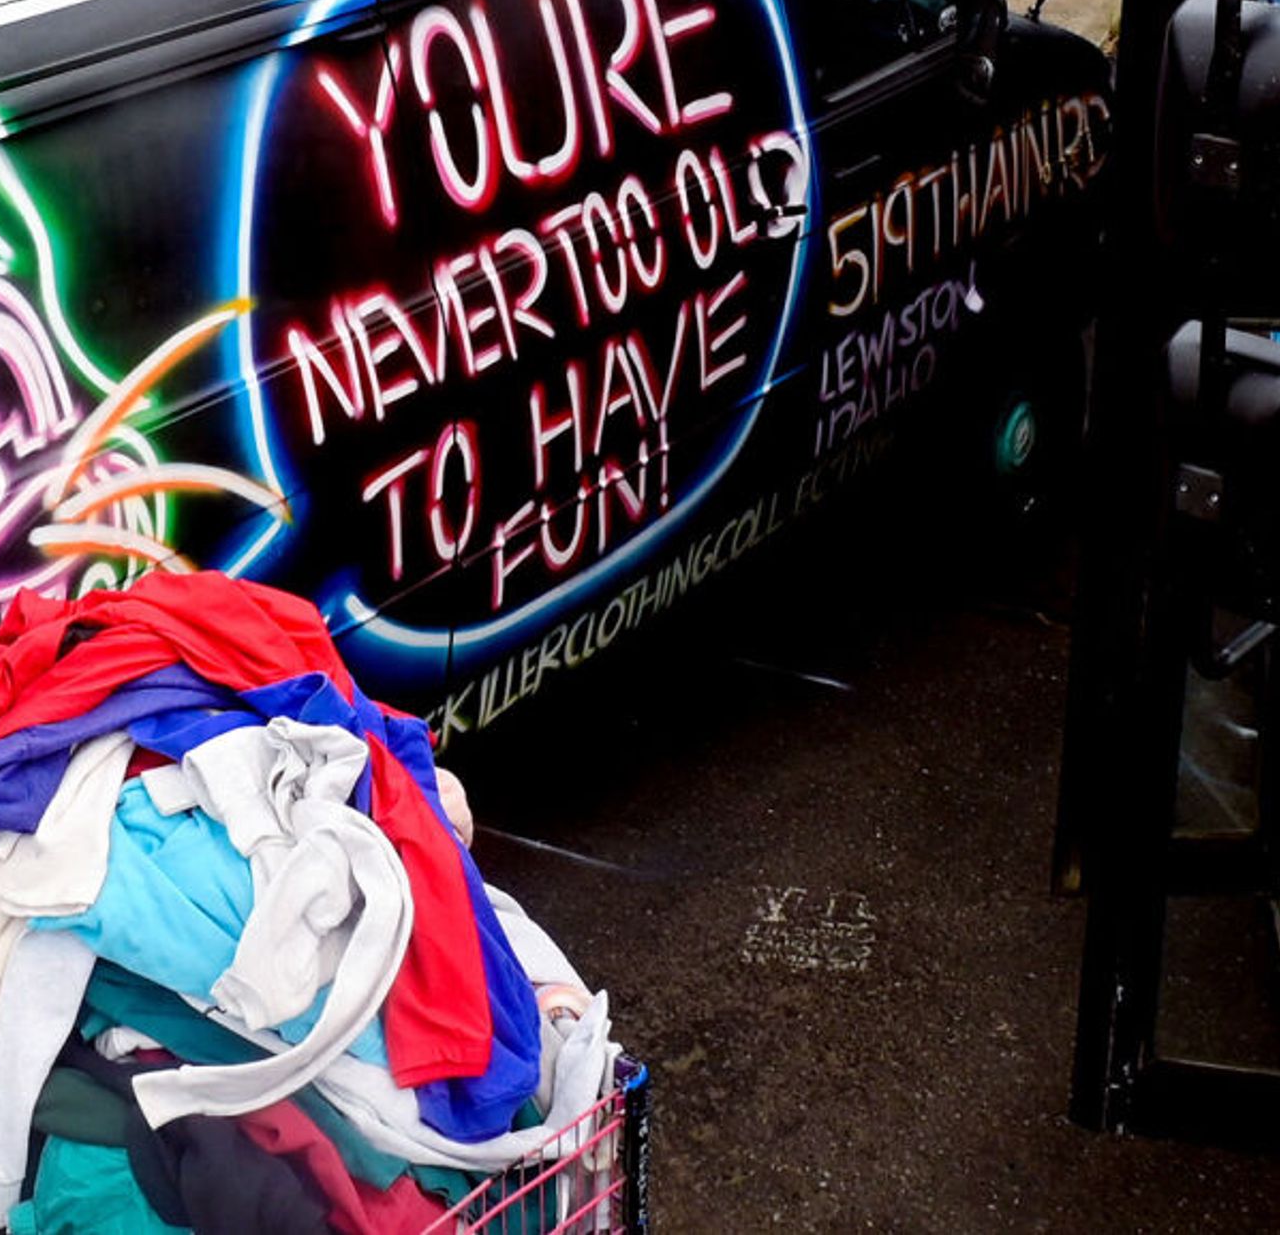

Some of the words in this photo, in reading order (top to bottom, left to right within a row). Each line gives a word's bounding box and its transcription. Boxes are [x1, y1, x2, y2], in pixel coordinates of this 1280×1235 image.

[286, 227, 556, 446] NEVER
[540, 176, 666, 327] TOO
[362, 422, 477, 580] TO
[530, 270, 748, 490] HAVE
